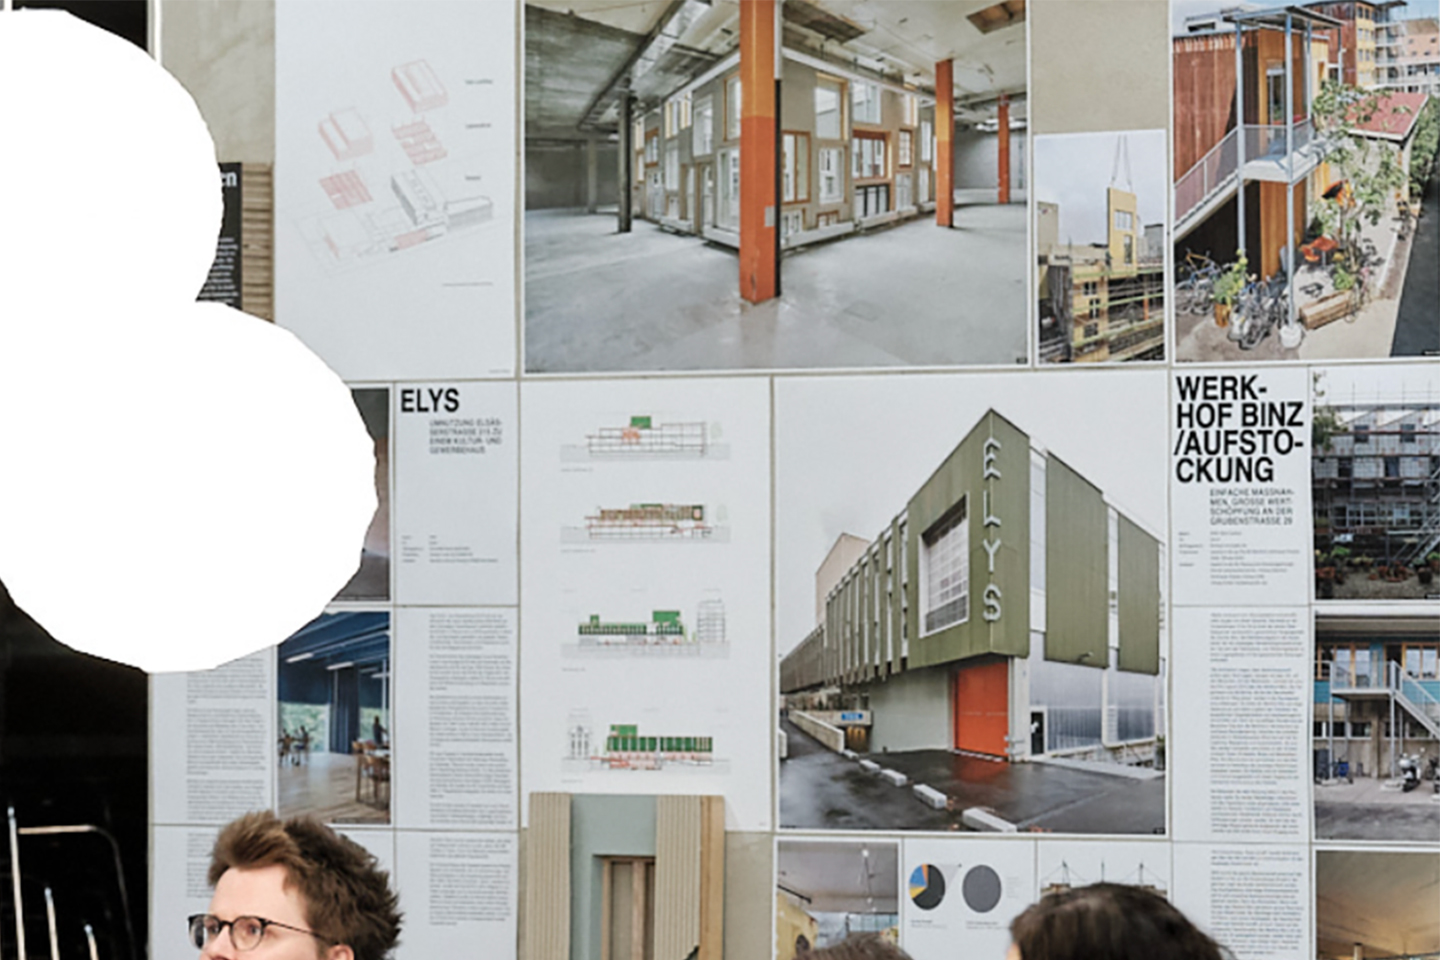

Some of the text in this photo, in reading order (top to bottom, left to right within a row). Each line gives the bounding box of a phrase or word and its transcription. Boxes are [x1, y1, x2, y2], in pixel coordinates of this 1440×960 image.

[401, 387, 460, 413] ELYS
[1176, 375, 1267, 401] WERK-
[1176, 402, 1304, 429] HOF BINZ
[1173, 429, 1304, 456] /AUFSTO-
[1176, 457, 1274, 484] CKUNG
[983, 436, 1002, 622] ELYS
